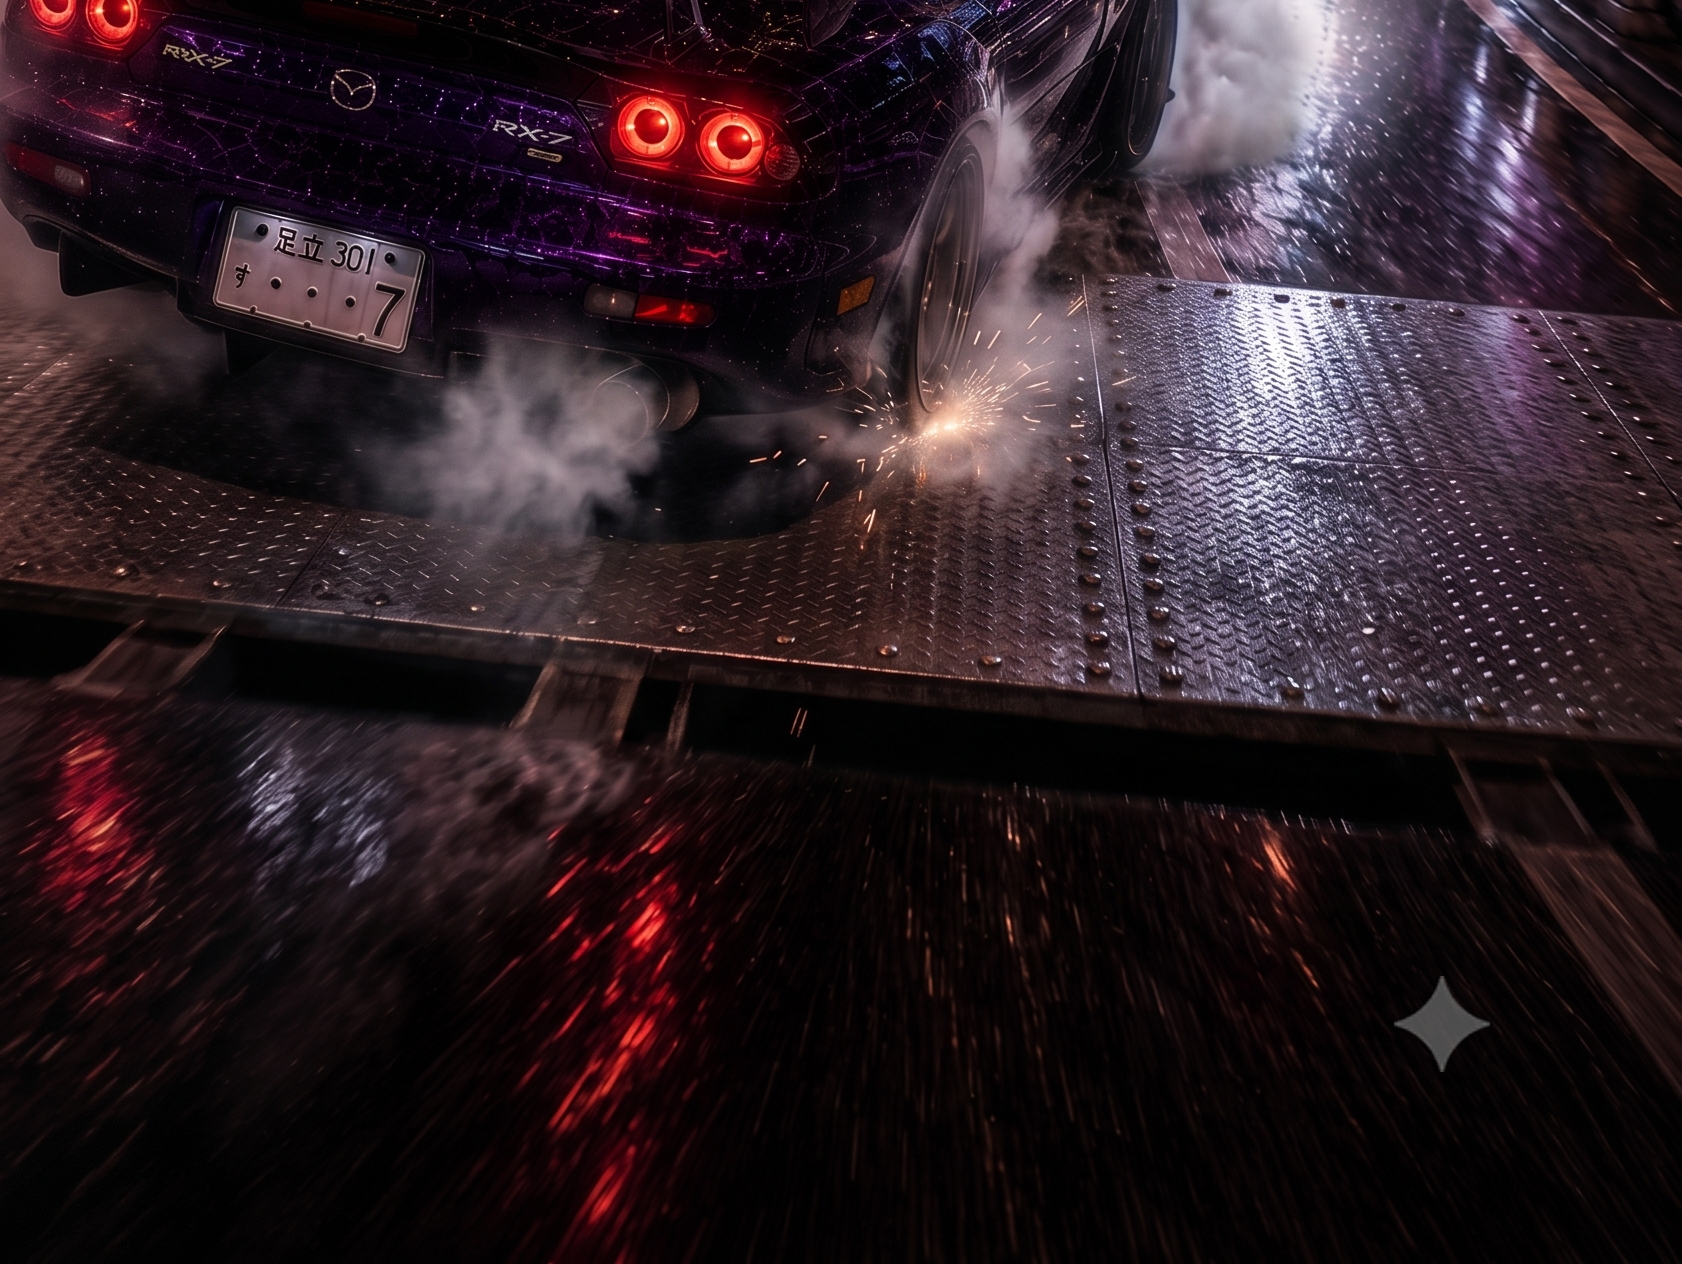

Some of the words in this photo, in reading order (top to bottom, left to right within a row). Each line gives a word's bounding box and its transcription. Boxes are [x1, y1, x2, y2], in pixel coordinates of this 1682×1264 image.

[492, 119, 573, 145] RX-7
[273, 226, 325, 264] 足立
[330, 240, 377, 276] 301
